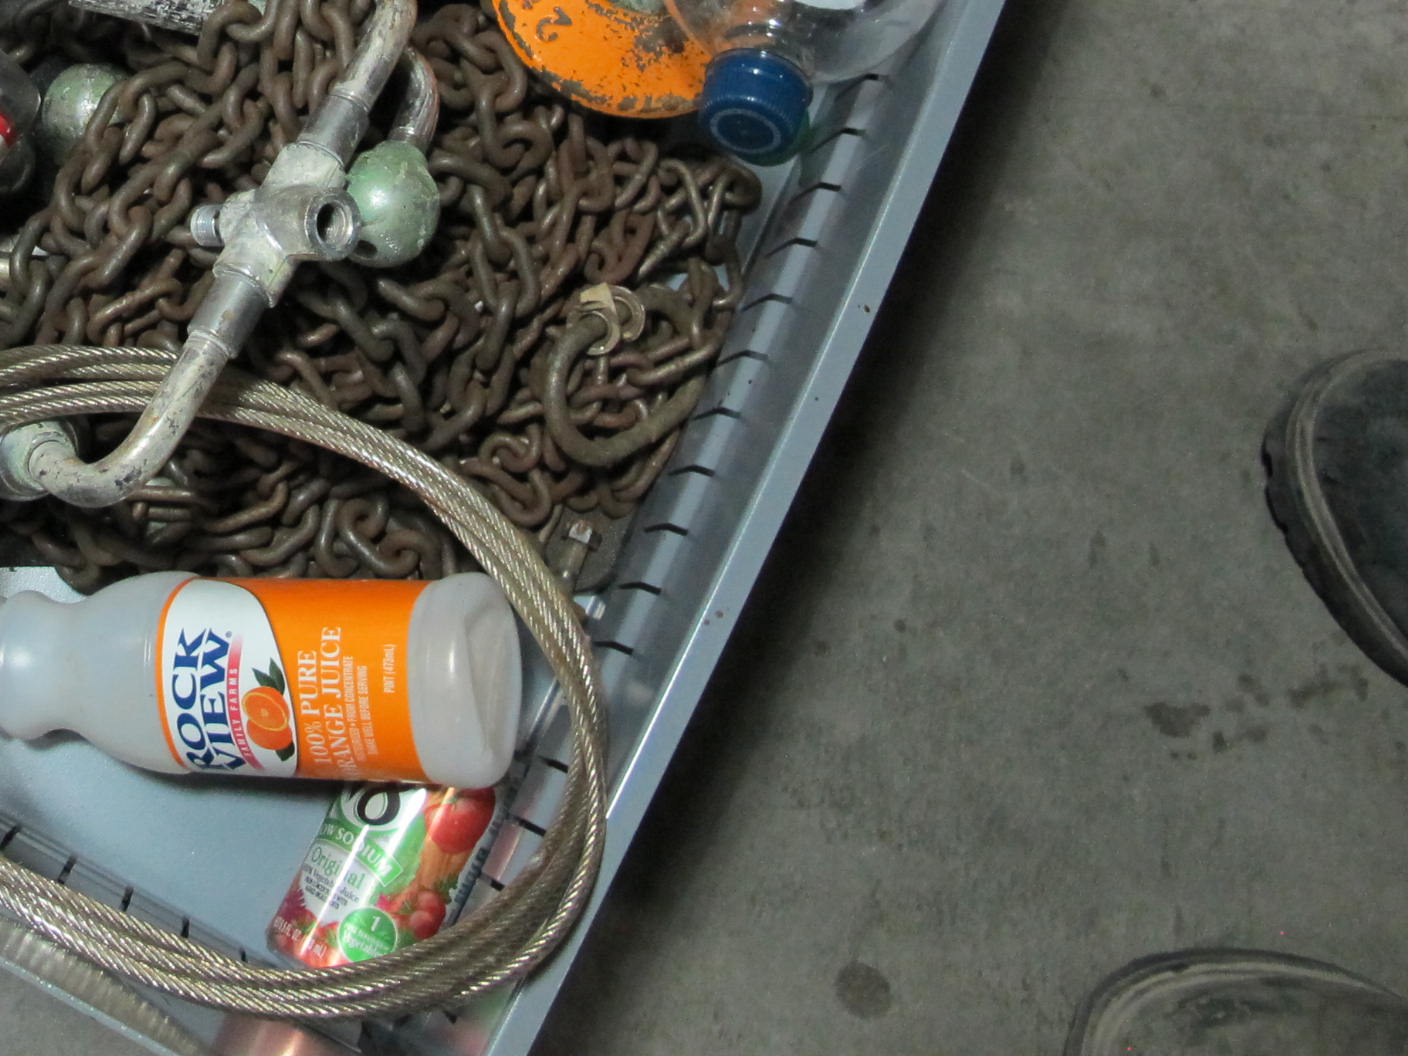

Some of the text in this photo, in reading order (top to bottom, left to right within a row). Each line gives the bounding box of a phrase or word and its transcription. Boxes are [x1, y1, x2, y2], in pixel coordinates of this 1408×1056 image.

[320, 626, 342, 699] JUICE
[343, 656, 356, 704] CONCENTRATE
[357, 665, 369, 695] SERVING
[382, 644, 397, 694] PINT (473mL)
[172, 627, 222, 771] ROCK
[199, 628, 246, 772] VIEW
[228, 667, 253, 759] FAMILY FARMS
[297, 650, 332, 765] 100% PURE
[347, 704, 357, 722] FROM
[359, 695, 371, 725] BEFORE
[311, 845, 366, 890] Origial
[335, 826, 394, 878] SOIUM
[370, 916, 382, 932] 1
